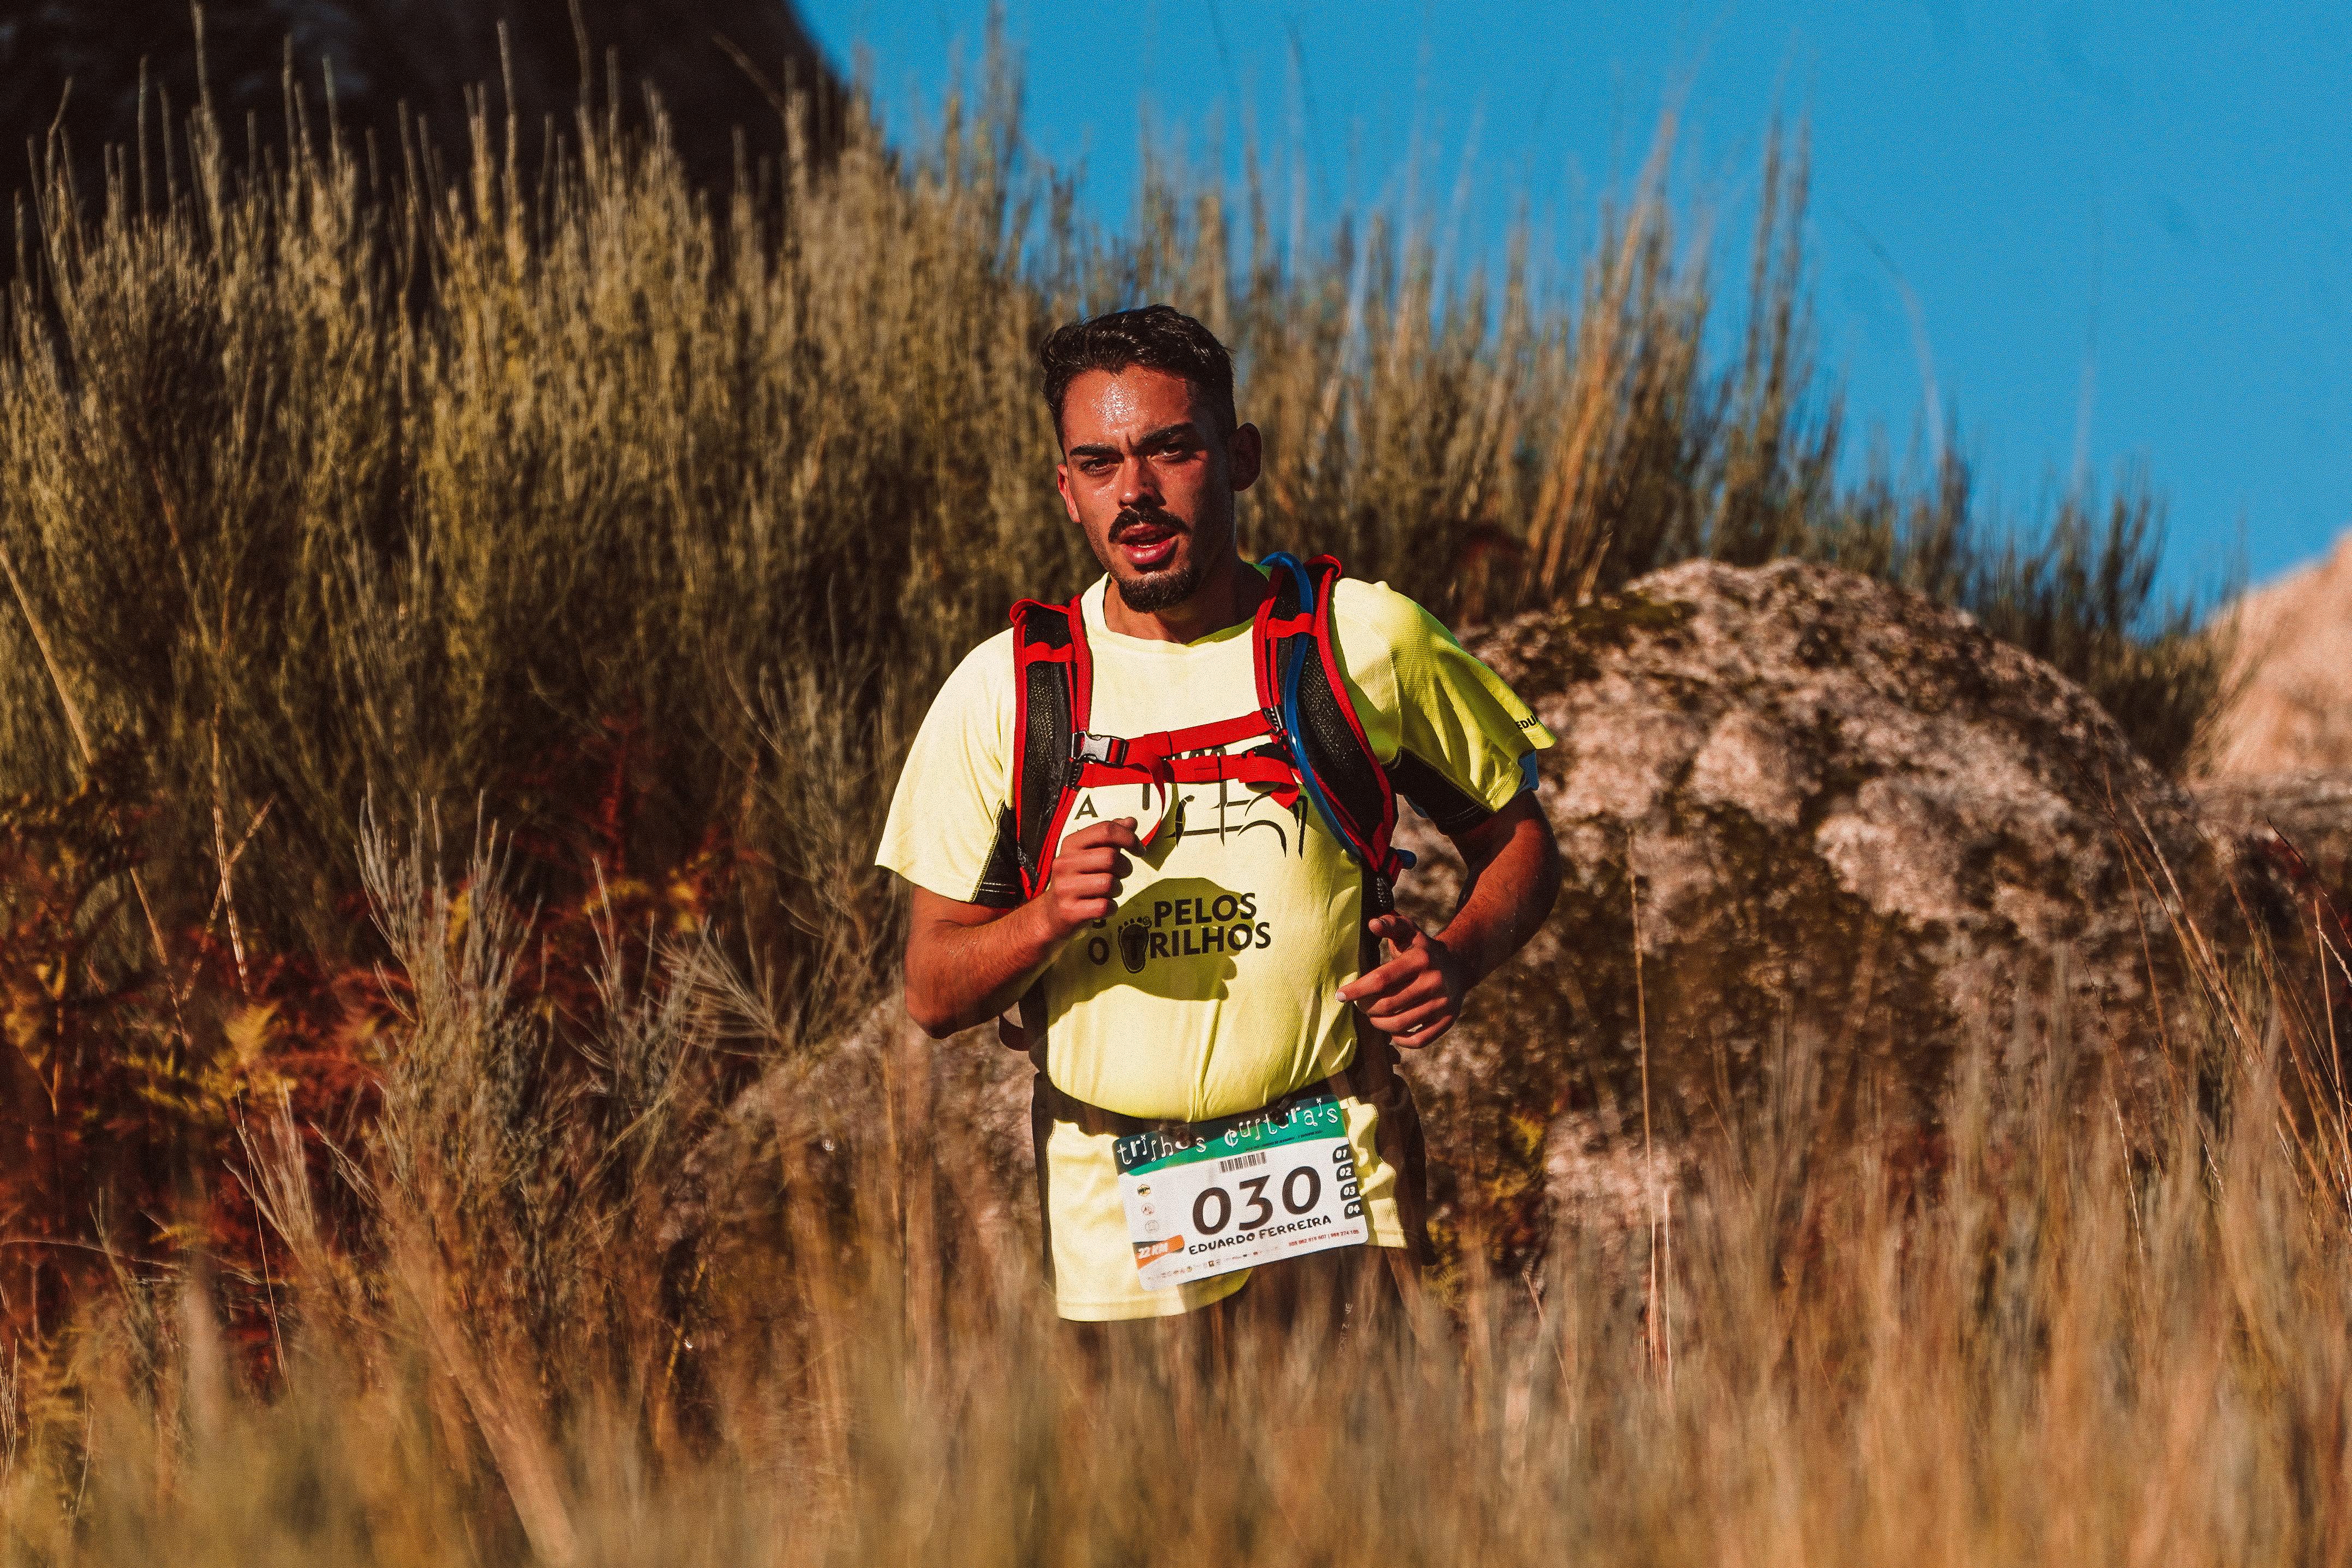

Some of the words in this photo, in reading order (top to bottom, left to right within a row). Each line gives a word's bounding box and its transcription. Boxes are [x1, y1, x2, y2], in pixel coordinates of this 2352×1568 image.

[1515, 715, 1539, 729] EDU
[1154, 893, 1256, 927] PELOS
[1336, 1149, 1348, 1159] 01
[1339, 1167, 1352, 1177] 02
[1343, 1186, 1356, 1196] 03
[1192, 1166, 1321, 1235] 030
[1348, 1204, 1360, 1214] 04
[1189, 1232, 1255, 1255] EDUARDO
[1259, 1214, 1332, 1240] FERREIRA
